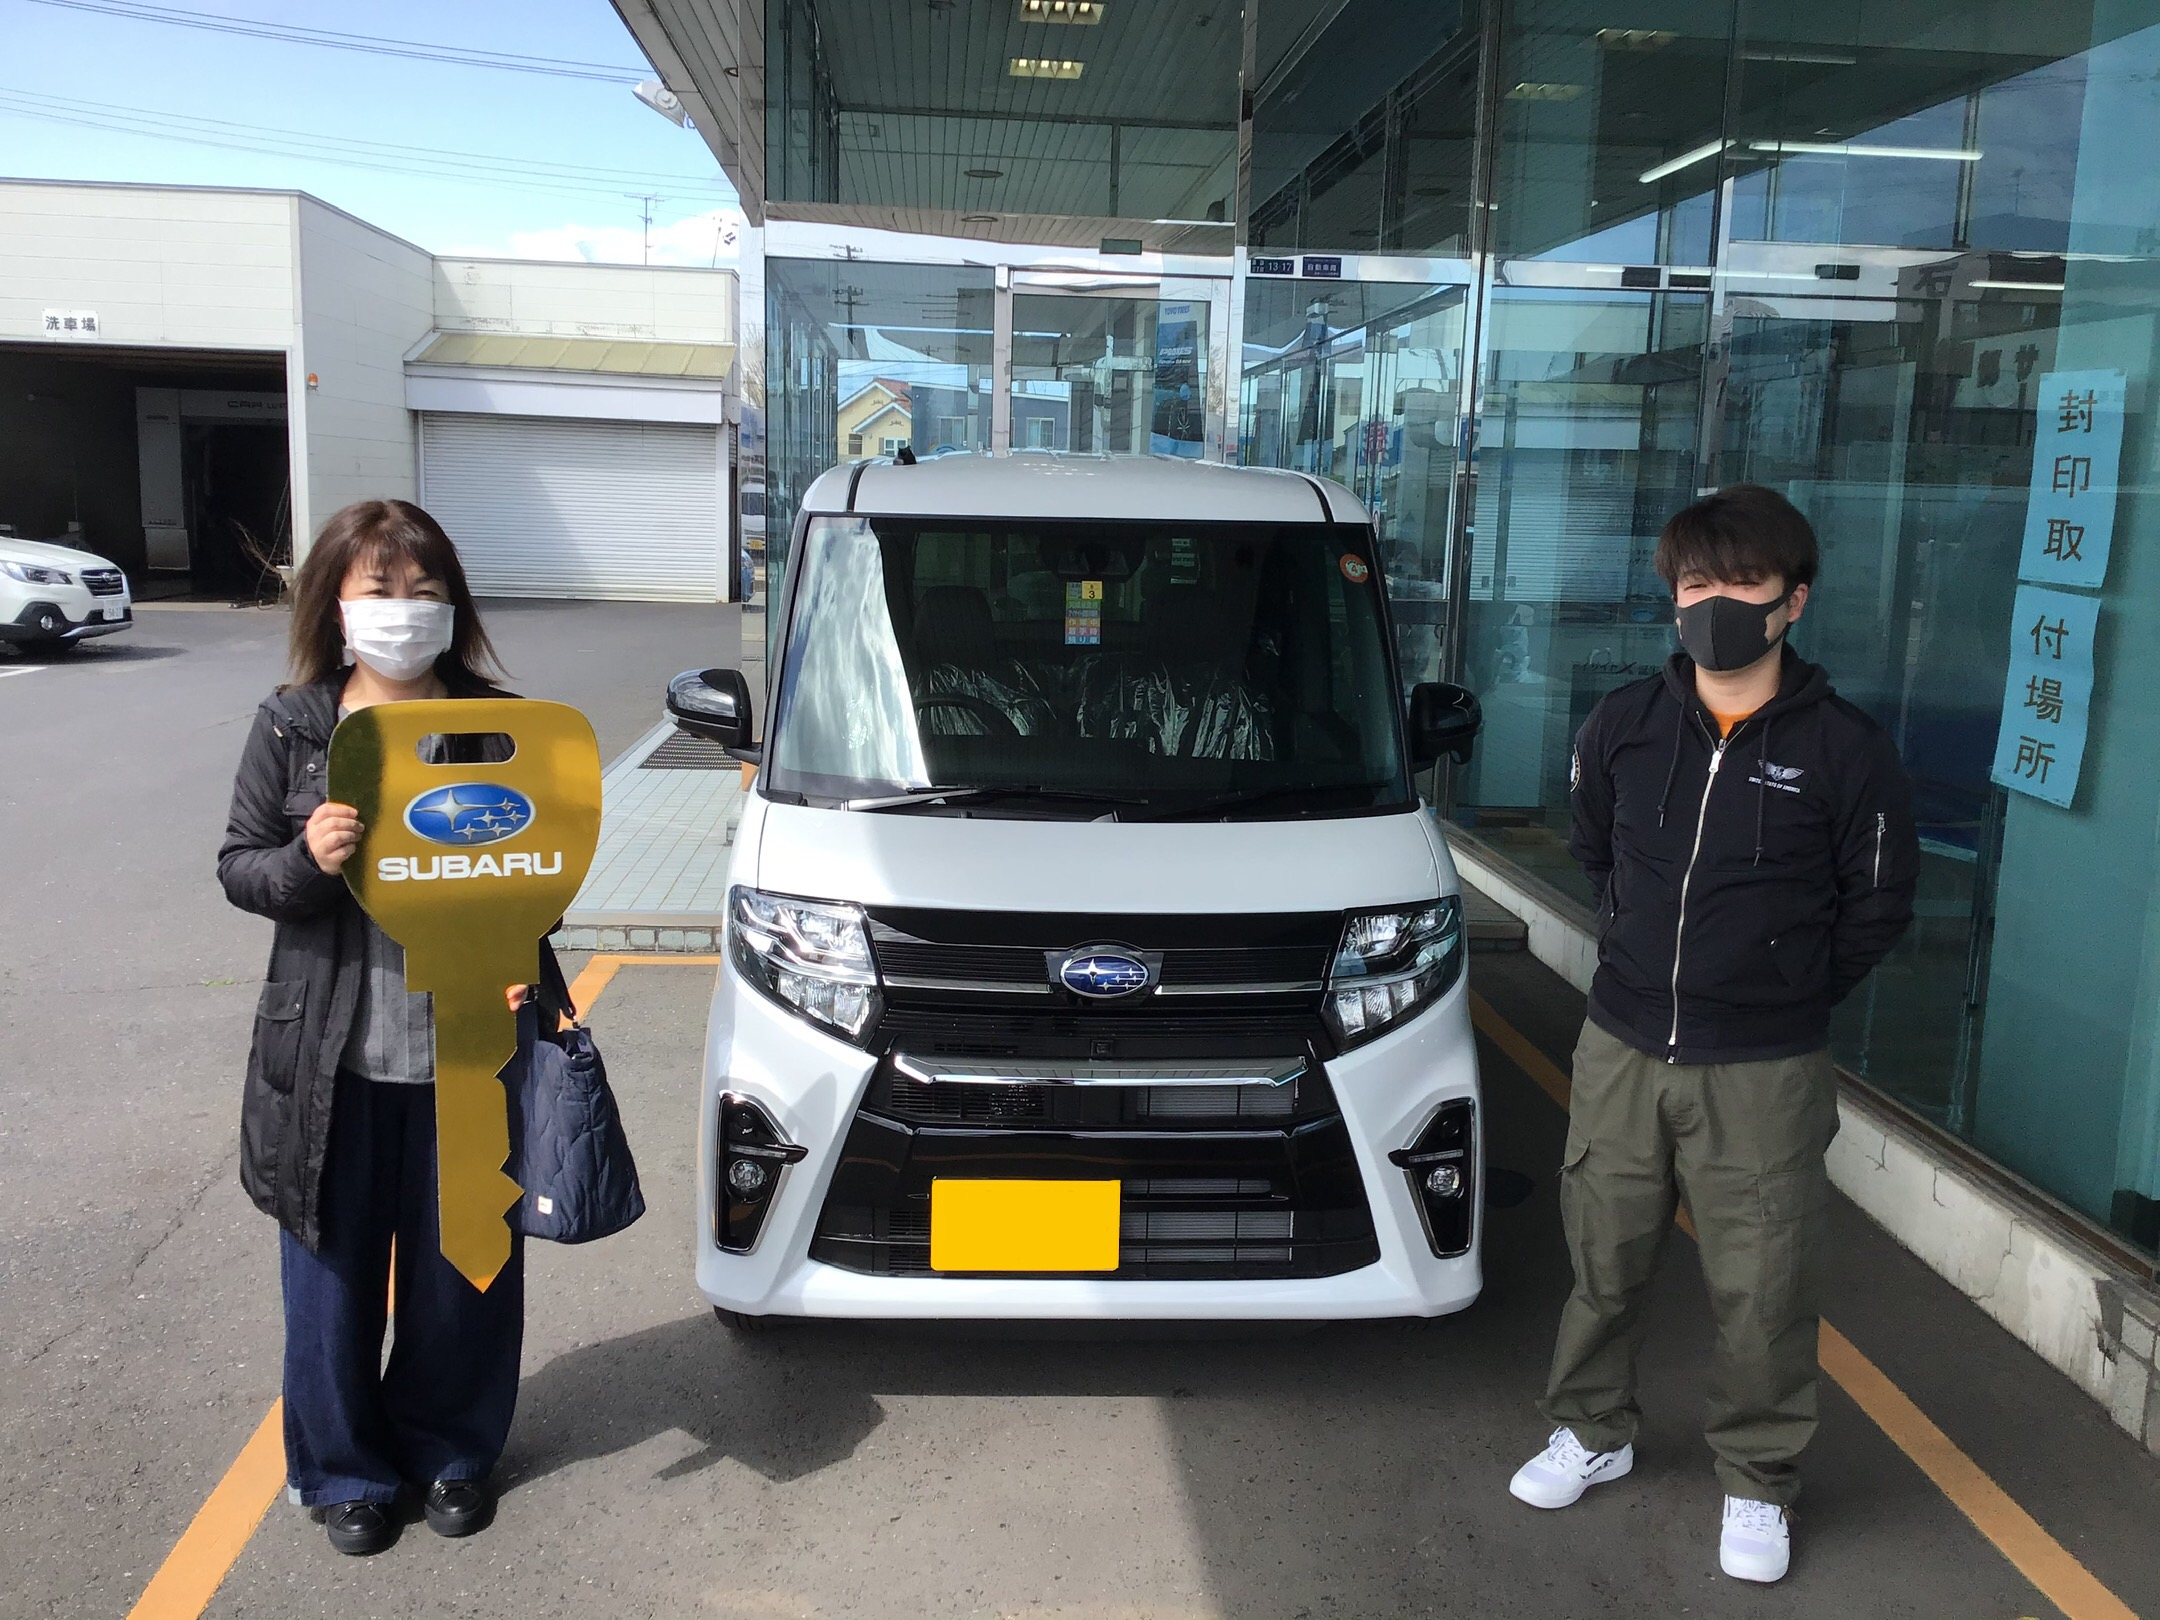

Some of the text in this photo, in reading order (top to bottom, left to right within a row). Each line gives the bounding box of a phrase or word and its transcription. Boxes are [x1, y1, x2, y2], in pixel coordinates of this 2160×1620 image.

[45, 315, 96, 332] 洗車場
[2042, 388, 2098, 562] 封印取
[2012, 614, 2070, 783] 付場所
[377, 851, 562, 881] SUBARU
